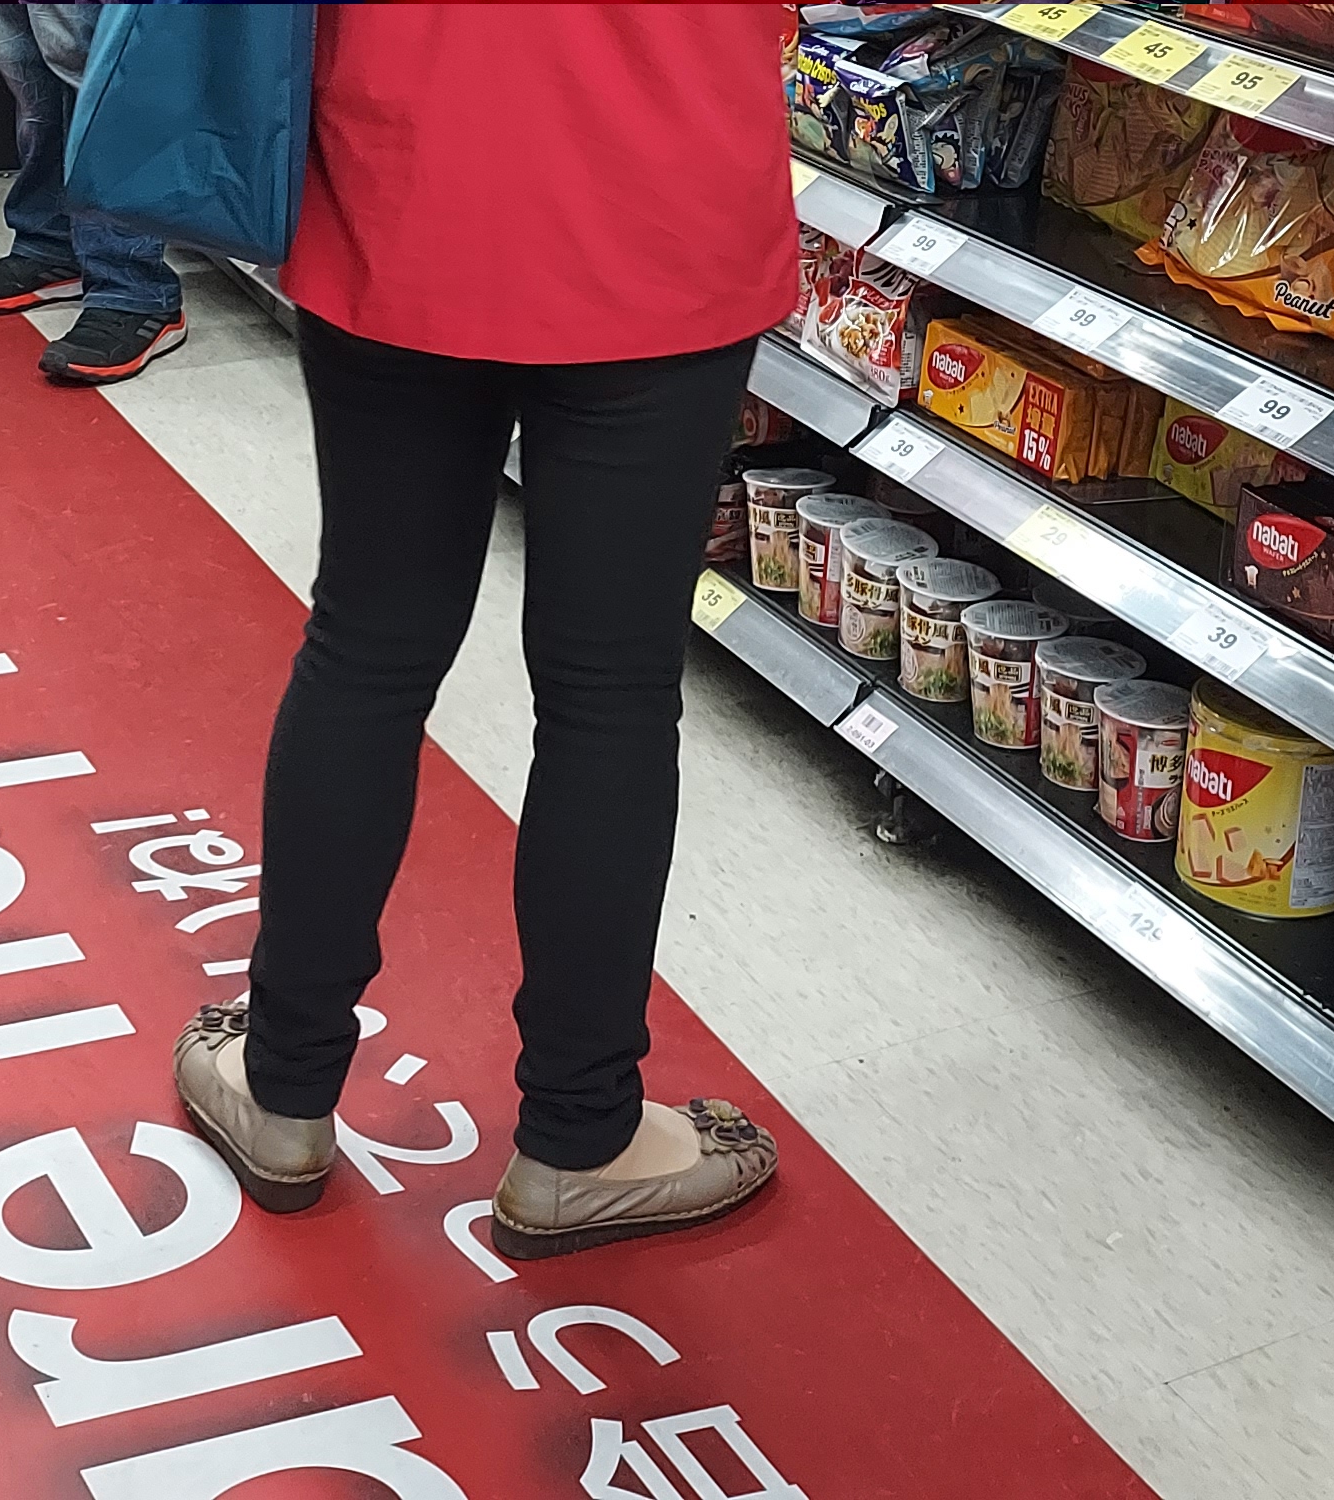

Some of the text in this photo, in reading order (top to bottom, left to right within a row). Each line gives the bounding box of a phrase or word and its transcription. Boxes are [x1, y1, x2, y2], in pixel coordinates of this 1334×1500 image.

[1037, 5, 1068, 21] 45
[1142, 42, 1175, 61] 45
[1229, 69, 1264, 91] 95
[912, 236, 937, 253] 99
[1068, 308, 1097, 328] 99
[930, 349, 967, 383] nabati
[1027, 382, 1059, 414] EXTRA
[1257, 399, 1292, 421] 99
[889, 438, 915, 458] 39
[1021, 428, 1053, 472] 15%
[1170, 423, 1207, 456] nabati
[1251, 520, 1299, 560] nabati
[700, 587, 722, 607] 35
[1207, 626, 1238, 650] 39
